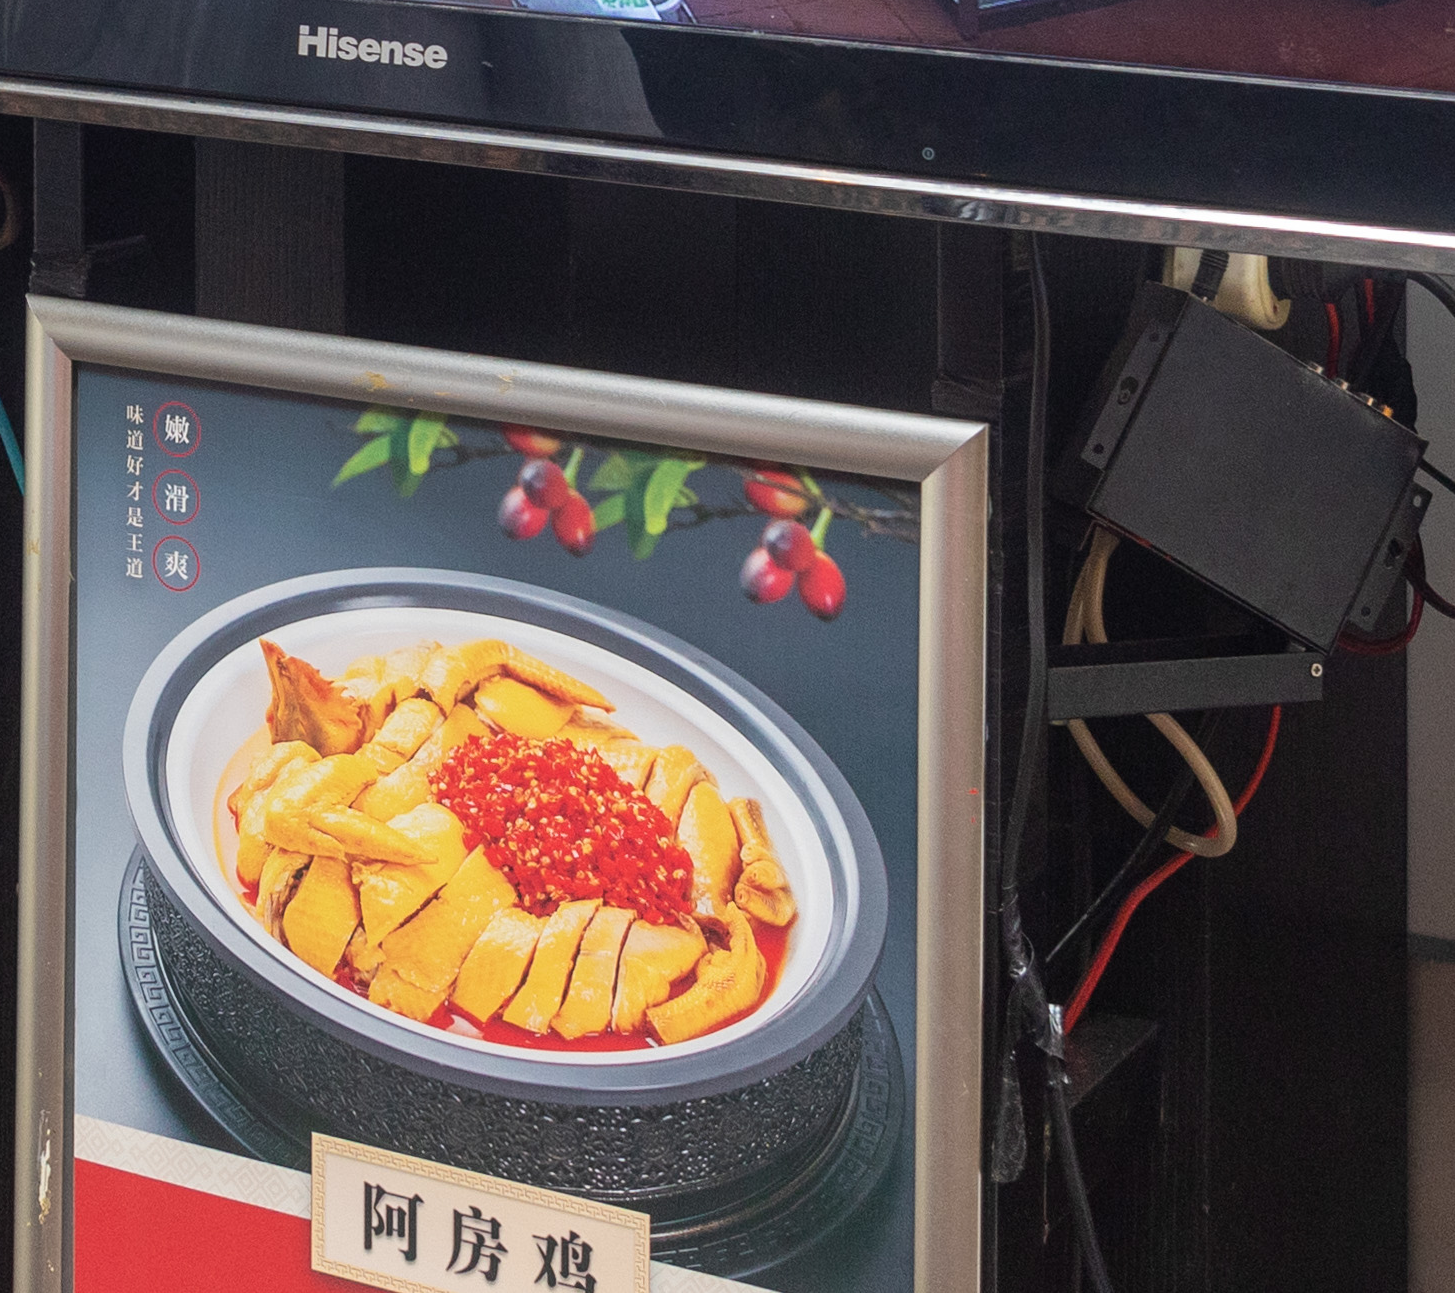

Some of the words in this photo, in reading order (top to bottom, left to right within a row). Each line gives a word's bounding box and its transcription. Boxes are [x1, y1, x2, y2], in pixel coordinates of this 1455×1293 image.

[298, 24, 448, 69] Hisense
[125, 405, 144, 579] 味道好才是王道
[363, 1180, 599, 1293] 阿房鸡
